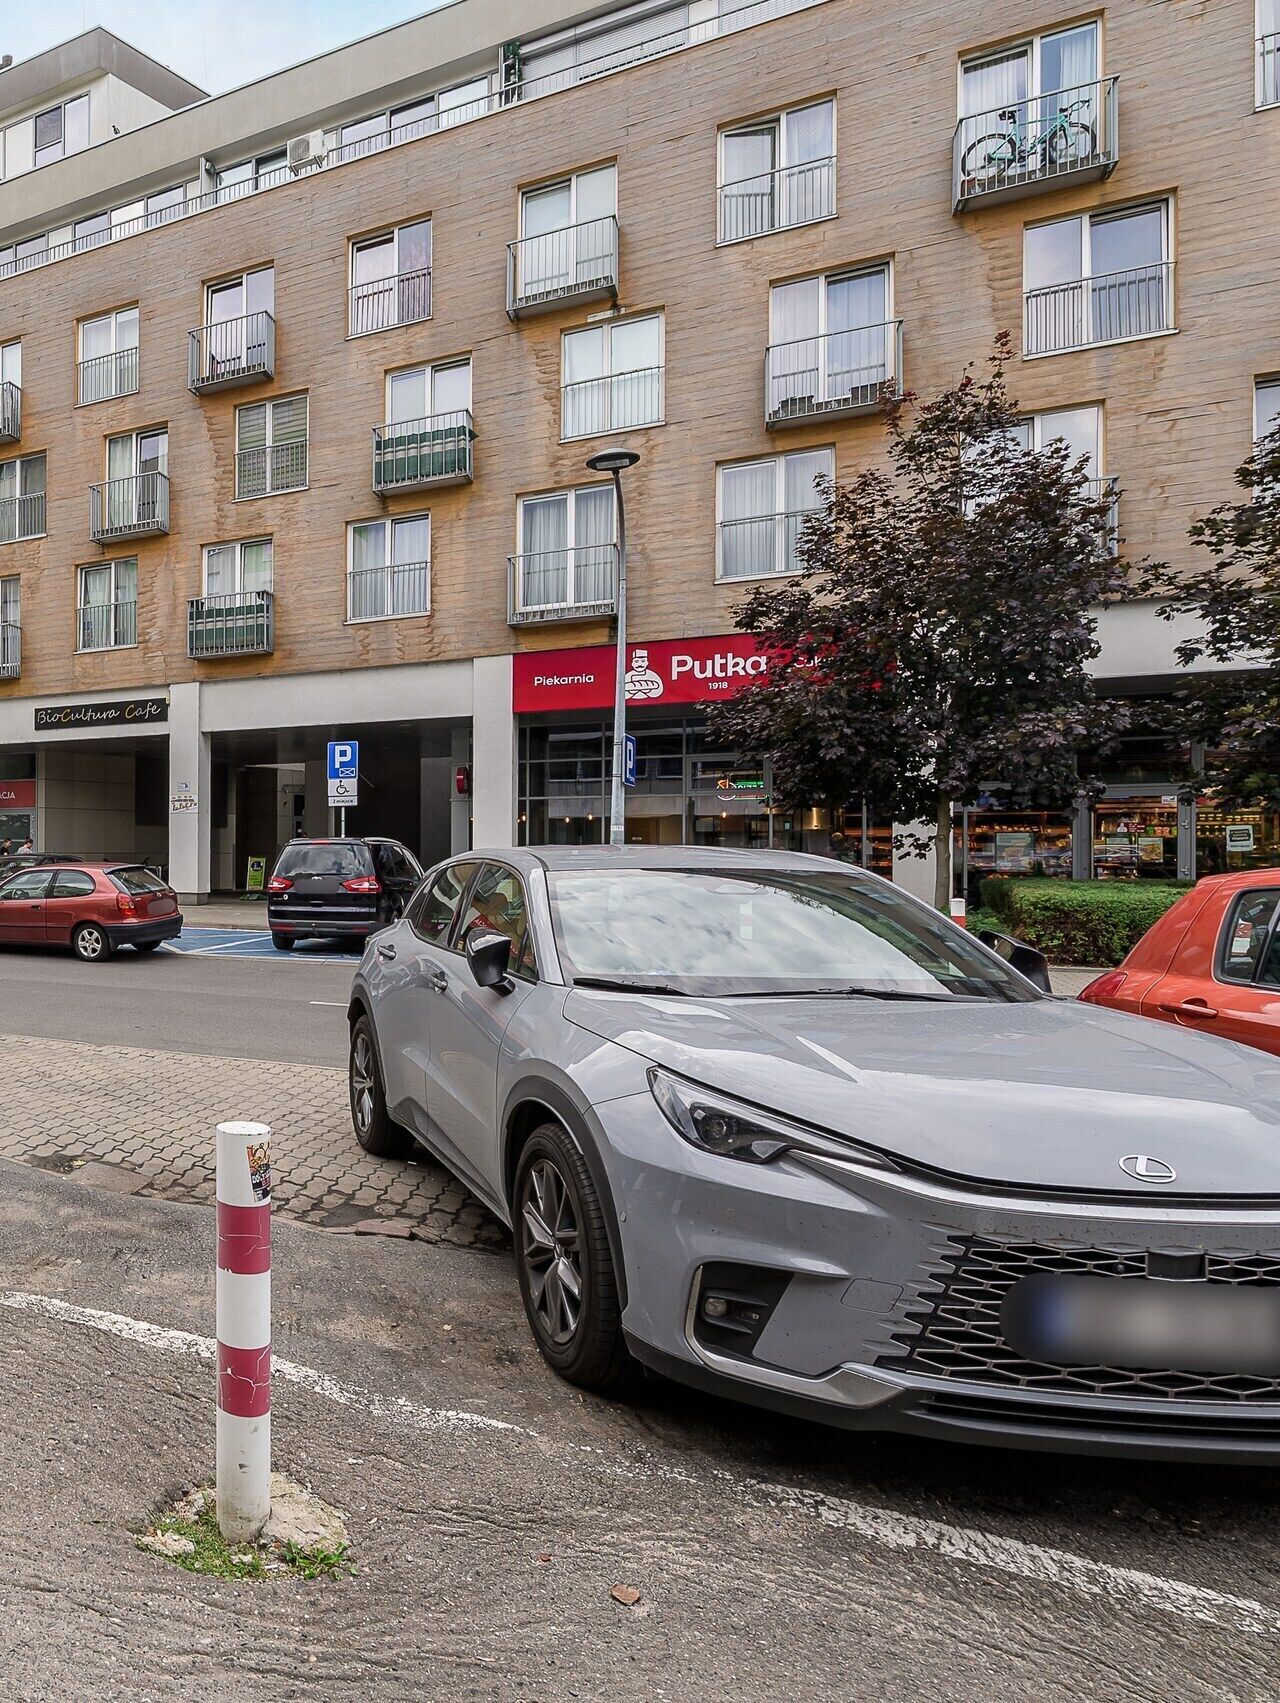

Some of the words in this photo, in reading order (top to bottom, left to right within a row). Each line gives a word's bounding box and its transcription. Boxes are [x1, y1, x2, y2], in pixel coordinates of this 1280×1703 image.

[671, 652, 767, 681] Putka
[534, 673, 594, 686] Piekarnia
[708, 681, 728, 690] 1918
[37, 708, 120, 724] BioCultura
[125, 702, 161, 719] Cafe
[335, 745, 351, 768] P
